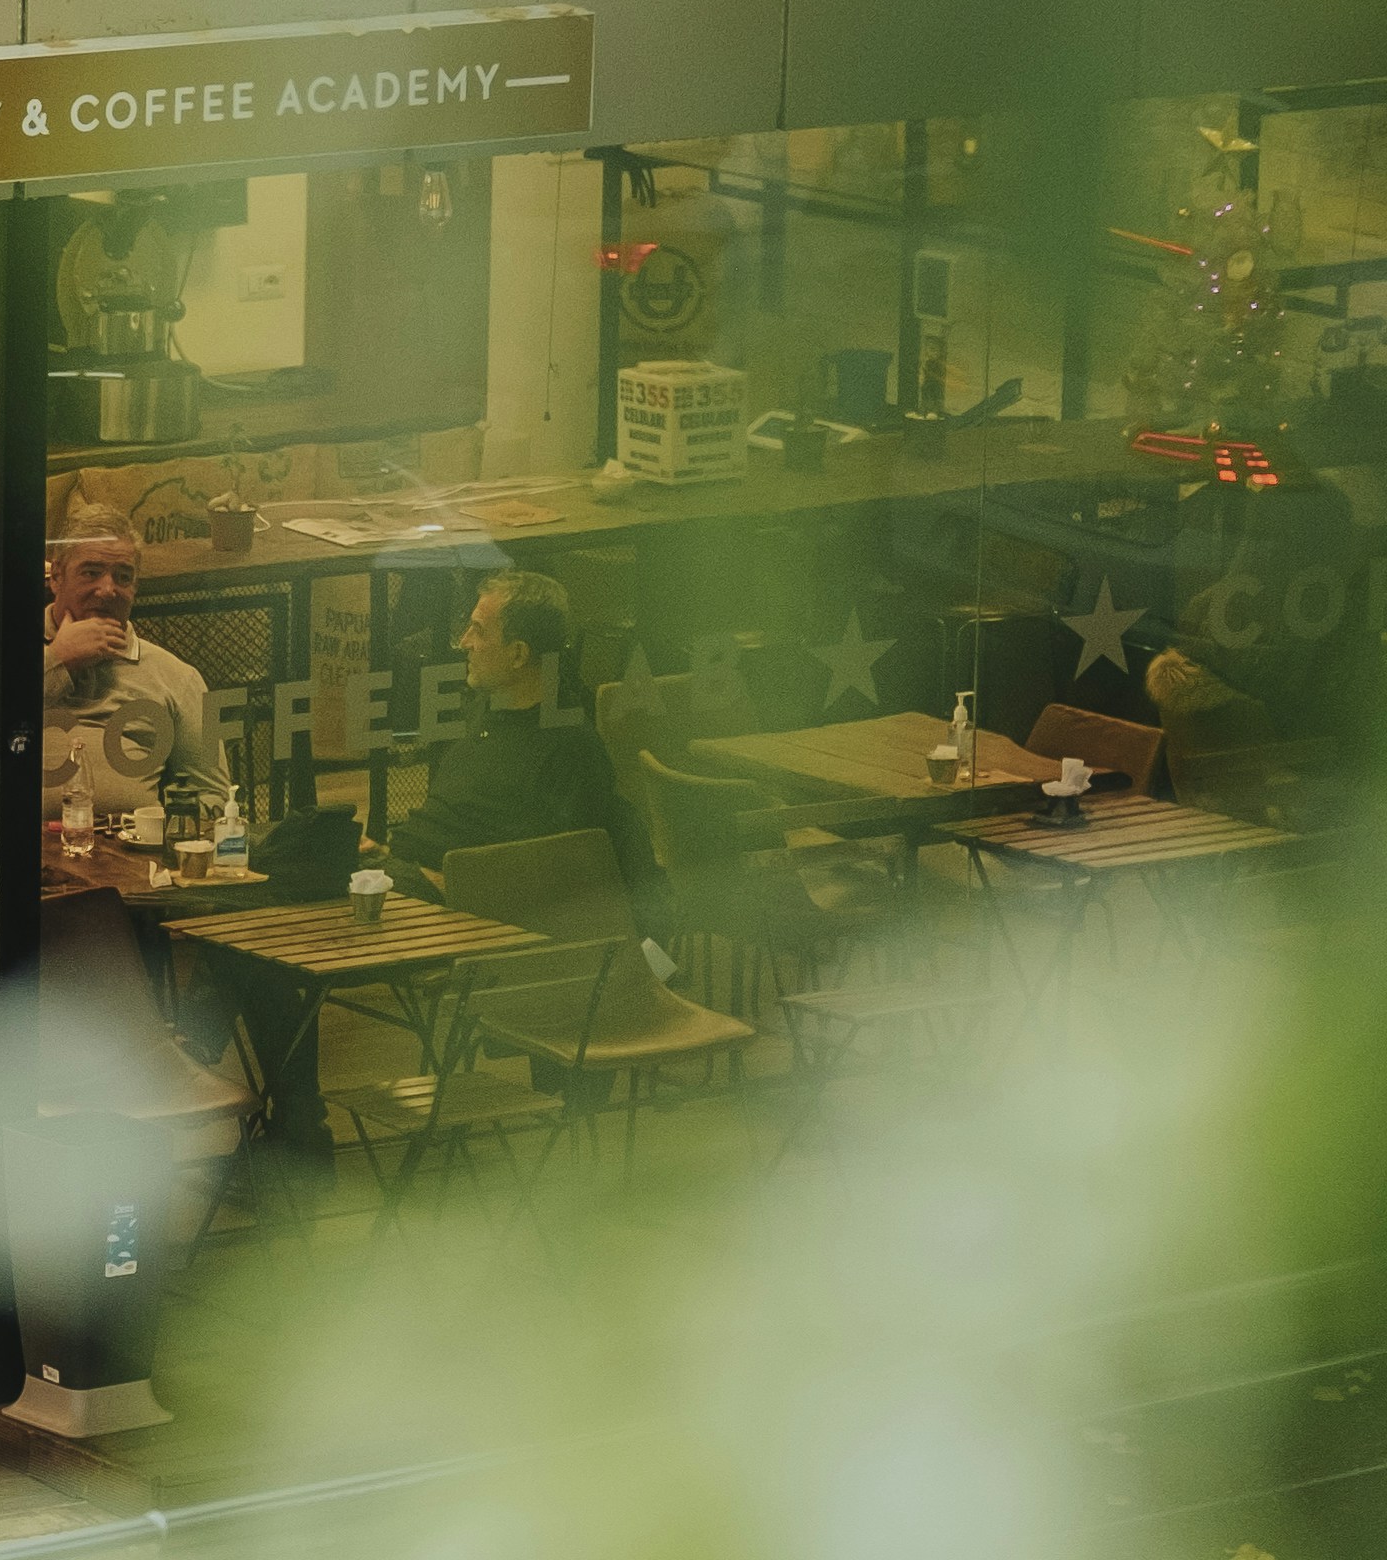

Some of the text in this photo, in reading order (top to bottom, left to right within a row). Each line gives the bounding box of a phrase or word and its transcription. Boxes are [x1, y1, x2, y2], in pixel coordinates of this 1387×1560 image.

[22, 98, 50, 137] &
[69, 80, 255, 134] COFFEE
[278, 63, 501, 117] ACADEMY
[635, 382, 670, 408] 355
